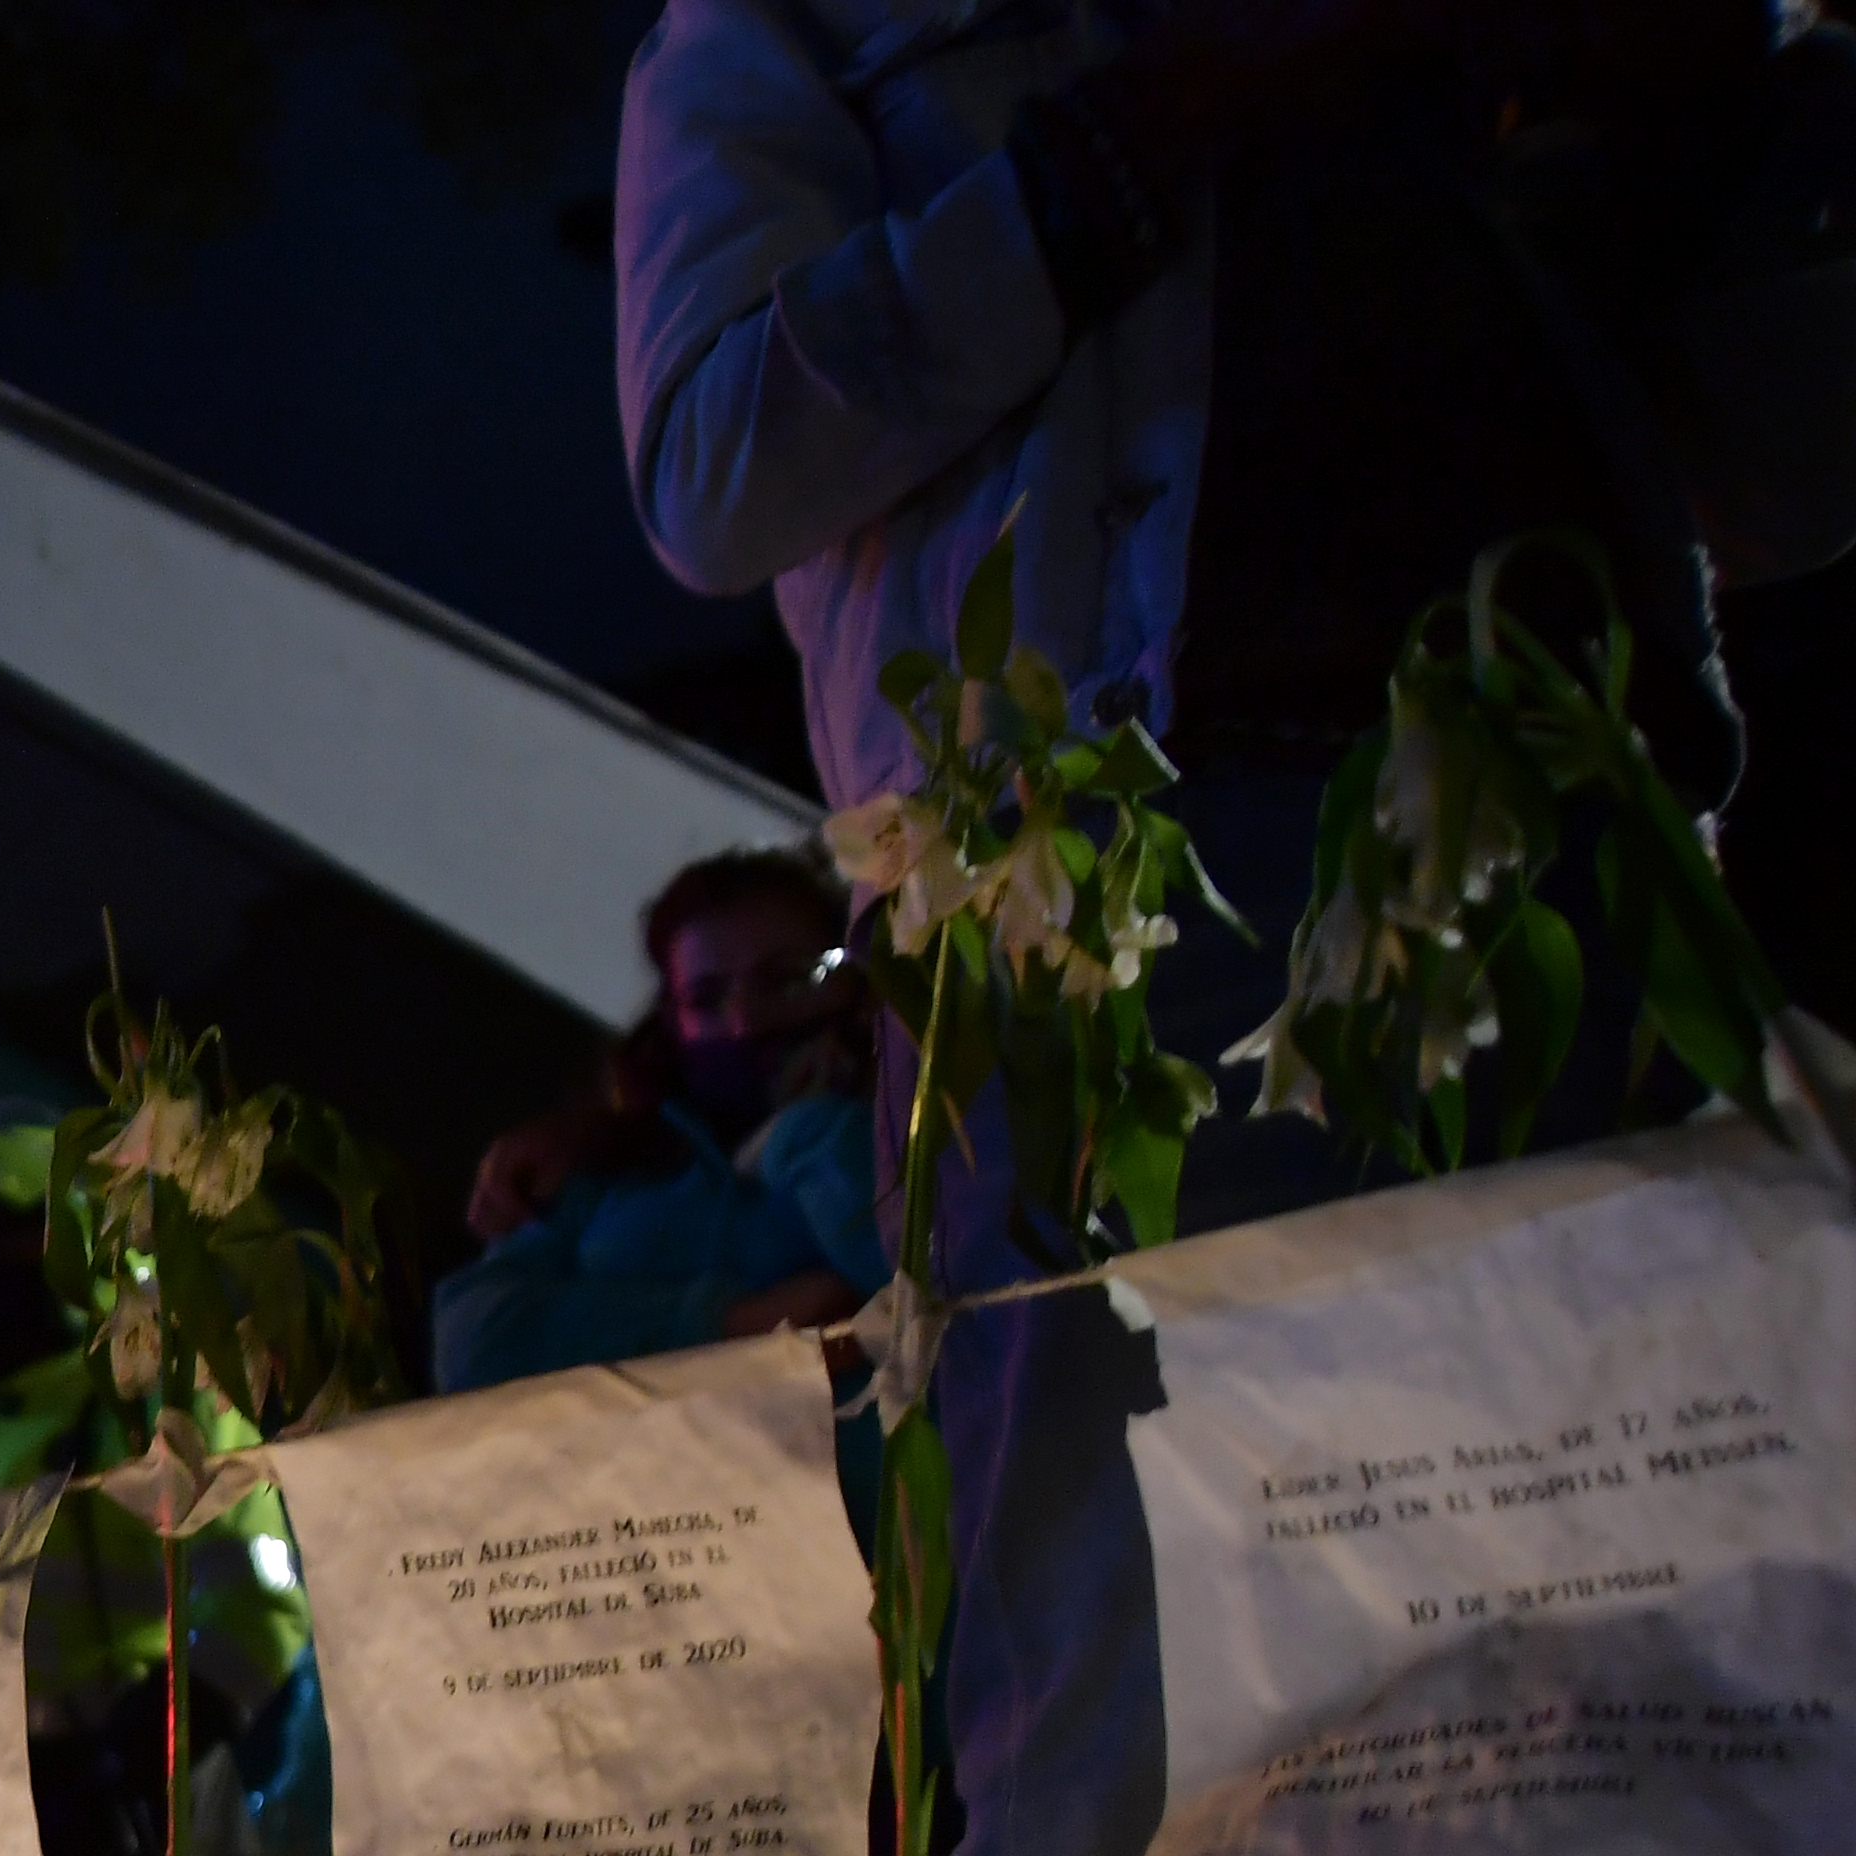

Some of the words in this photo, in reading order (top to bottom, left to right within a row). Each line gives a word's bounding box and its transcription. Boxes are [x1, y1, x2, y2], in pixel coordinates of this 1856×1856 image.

[1559, 1425, 1596, 1451] DE
[1618, 1411, 1648, 1440] 17
[1395, 1496, 1430, 1520] EN
[1491, 1461, 1627, 1510] HOSPITAL
[401, 1548, 465, 1575] FREDY
[478, 1527, 600, 1565] ALEXANDER
[733, 1505, 761, 1527] DE
[447, 1577, 476, 1602] 20
[668, 1547, 693, 1568] EN
[706, 1544, 729, 1565] EL
[1407, 1598, 1440, 1626] 10
[1457, 1594, 1487, 1617] DE
[1506, 1562, 1679, 1610] SEPTIEMBRE
[489, 1597, 592, 1629] HOSPITAL
[604, 1592, 630, 1612] DE
[642, 1581, 702, 1608] SUBA
[442, 1674, 456, 1696] 9
[466, 1672, 492, 1694] DE
[503, 1655, 623, 1690] SEPTIEMBRE
[639, 1650, 668, 1672] DE
[683, 1634, 746, 1665] 2020
[647, 1809, 671, 1831] DE
[686, 1801, 714, 1825] 25
[689, 1836, 712, 1856] DE
